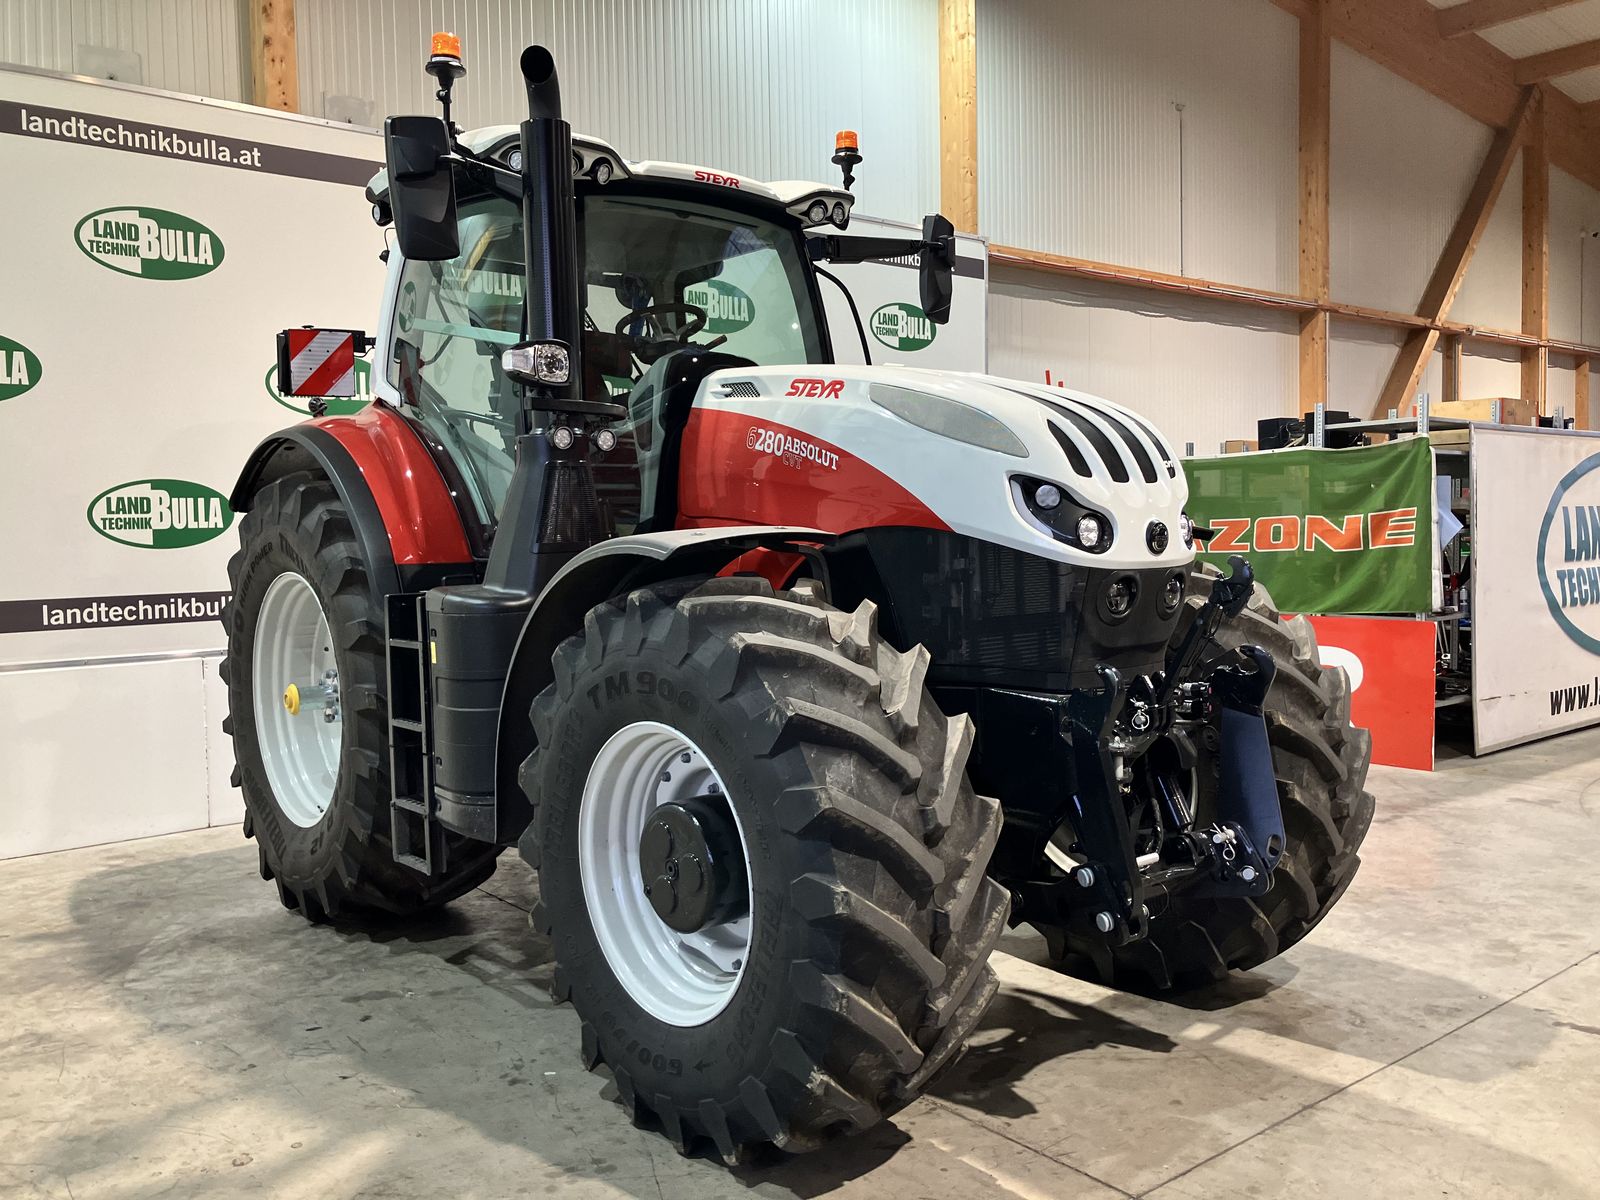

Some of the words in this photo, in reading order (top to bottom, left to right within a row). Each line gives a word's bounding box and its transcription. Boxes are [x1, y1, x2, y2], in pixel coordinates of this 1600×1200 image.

[20, 109, 262, 167] landtechnikbulla.at
[694, 170, 740, 189] STEYR
[93, 218, 139, 242] LAND
[87, 239, 140, 258] TECHNIK
[138, 217, 214, 266] BULLA
[686, 290, 708, 306] AND
[708, 287, 749, 322] BULLA
[878, 313, 898, 326] LAND
[898, 310, 931, 340] BULLA
[876, 326, 898, 337] TECHNIK
[785, 378, 845, 399] STEYR
[747, 427, 784, 456] 6280
[784, 435, 839, 470] ABSOLUT
[783, 452, 802, 470] CVT
[106, 496, 151, 515] LAND
[151, 489, 224, 530] BULLA
[100, 517, 153, 531] TECHNIK
[1556, 567, 1600, 608] TECH
[1550, 676, 1600, 716] www.l
